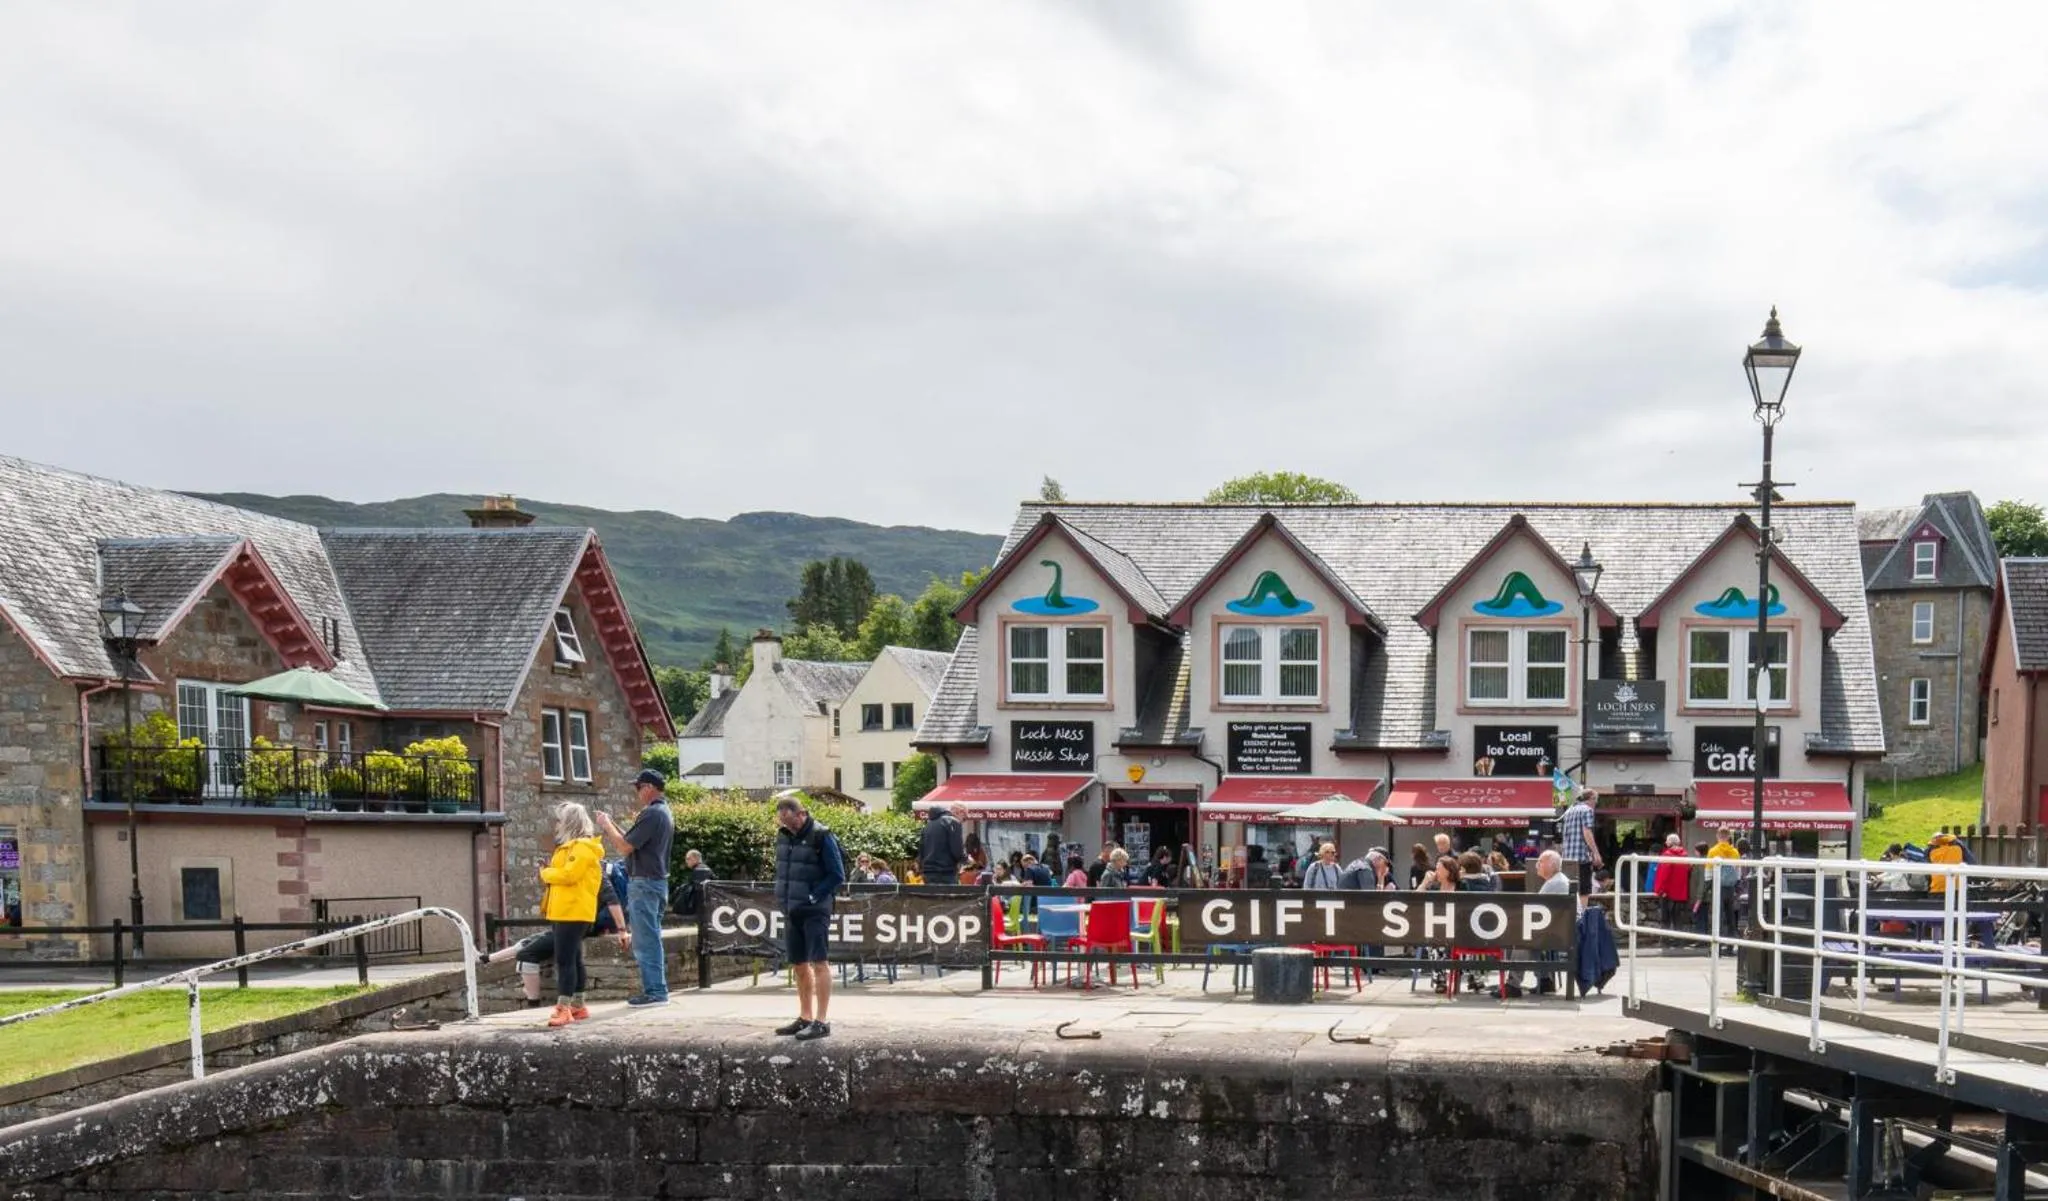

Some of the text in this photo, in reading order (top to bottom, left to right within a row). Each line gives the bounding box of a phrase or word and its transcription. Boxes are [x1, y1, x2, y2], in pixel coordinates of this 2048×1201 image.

[1597, 702, 1657, 712] LOCH NESS
[1020, 726, 1084, 740] Loch Ness
[1500, 731, 1532, 742] Local
[1487, 744, 1545, 756] Ice Cream
[1015, 747, 1089, 766] Nessie Shop
[1431, 787, 1516, 795] Cobbs
[1483, 818, 1505, 826] Coffee
[1814, 823, 1846, 831] Takeaway
[711, 905, 981, 944] COFEE SHOP
[1201, 899, 1553, 941] GIFT SHOP
